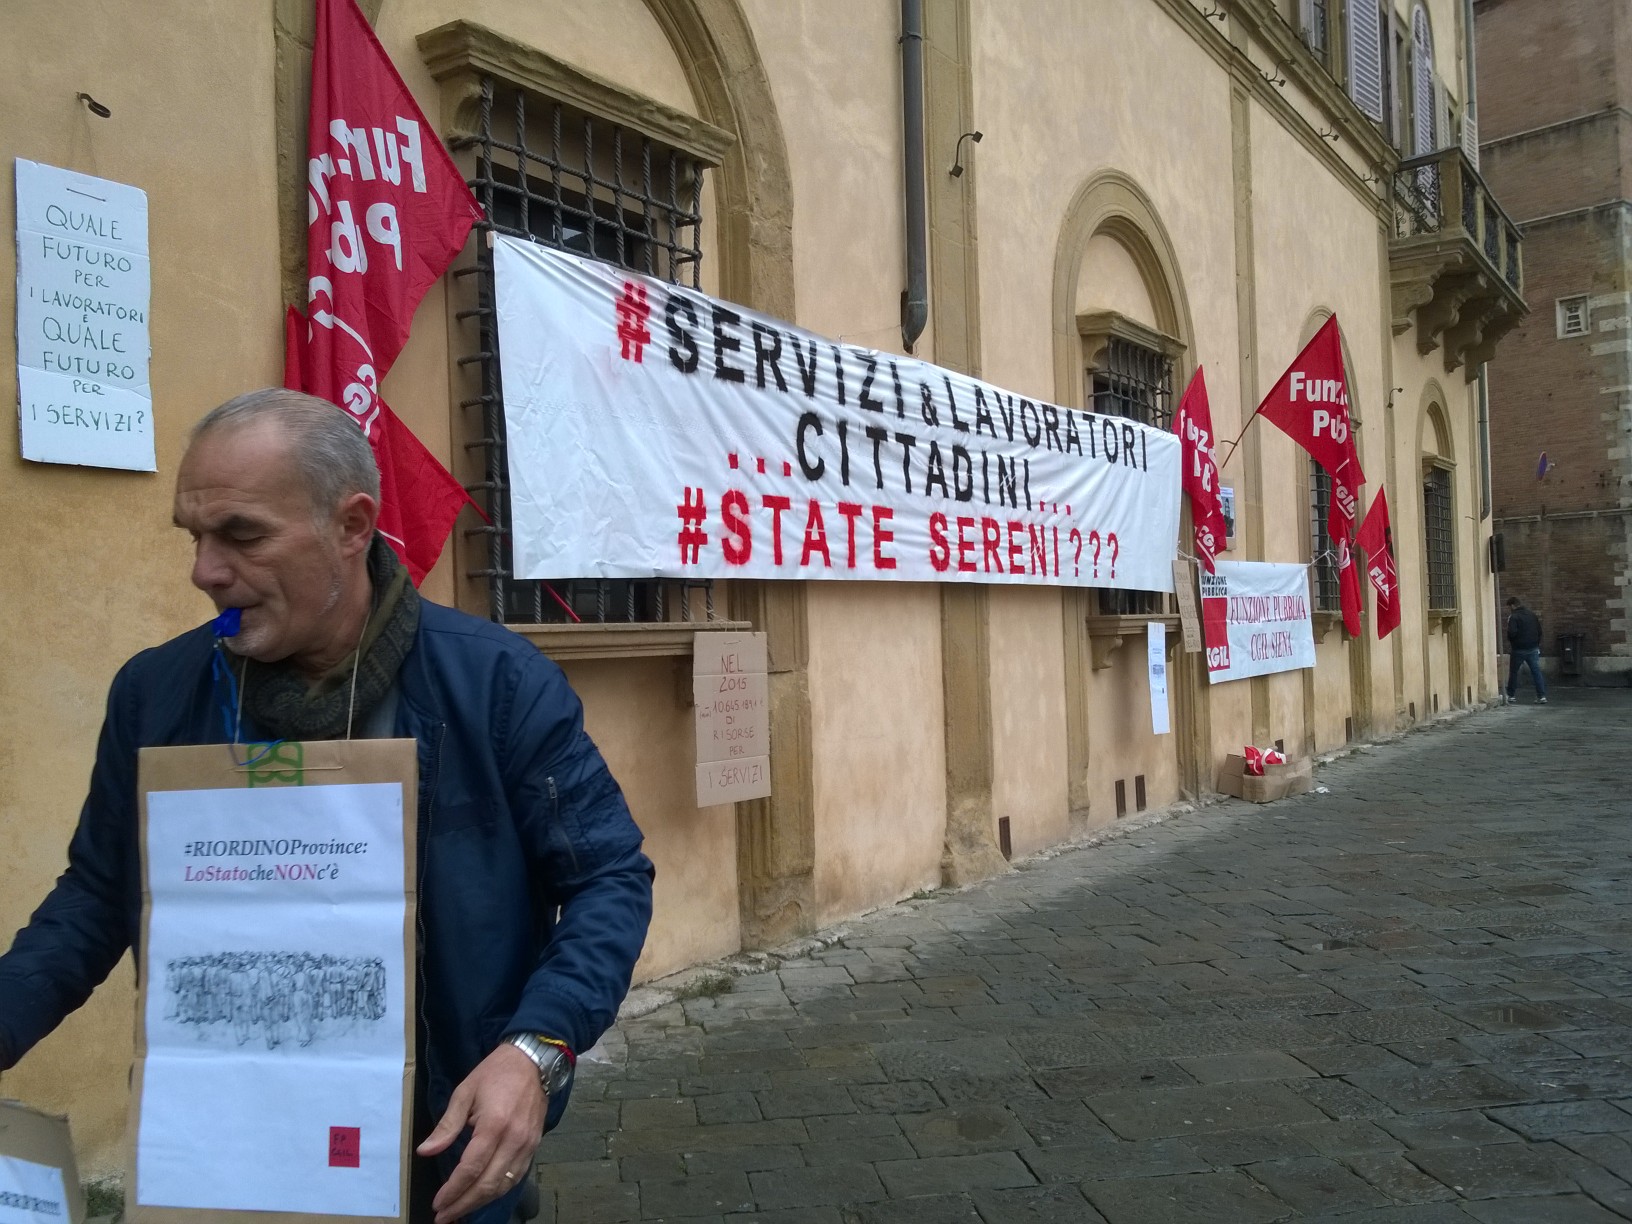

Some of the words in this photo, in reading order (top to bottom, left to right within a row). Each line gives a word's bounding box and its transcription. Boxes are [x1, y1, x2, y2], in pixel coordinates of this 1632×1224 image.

[46, 203, 122, 240] QUALE
[43, 235, 132, 273] FUTURO
[74, 269, 110, 288] PER
[42, 288, 144, 323] LAVORATORI
[43, 316, 126, 353] QUALE
[43, 351, 135, 380] FUTURO
[73, 380, 105, 396] PER
[47, 403, 144, 433] SERVIZI?
[928, 512, 1120, 580] SERENI???
[721, 653, 744, 673] NEL
[718, 676, 748, 694] 2015
[713, 725, 755, 741] RISORSE
[729, 745, 745, 756] PER
[718, 764, 763, 788] SERVIZI
